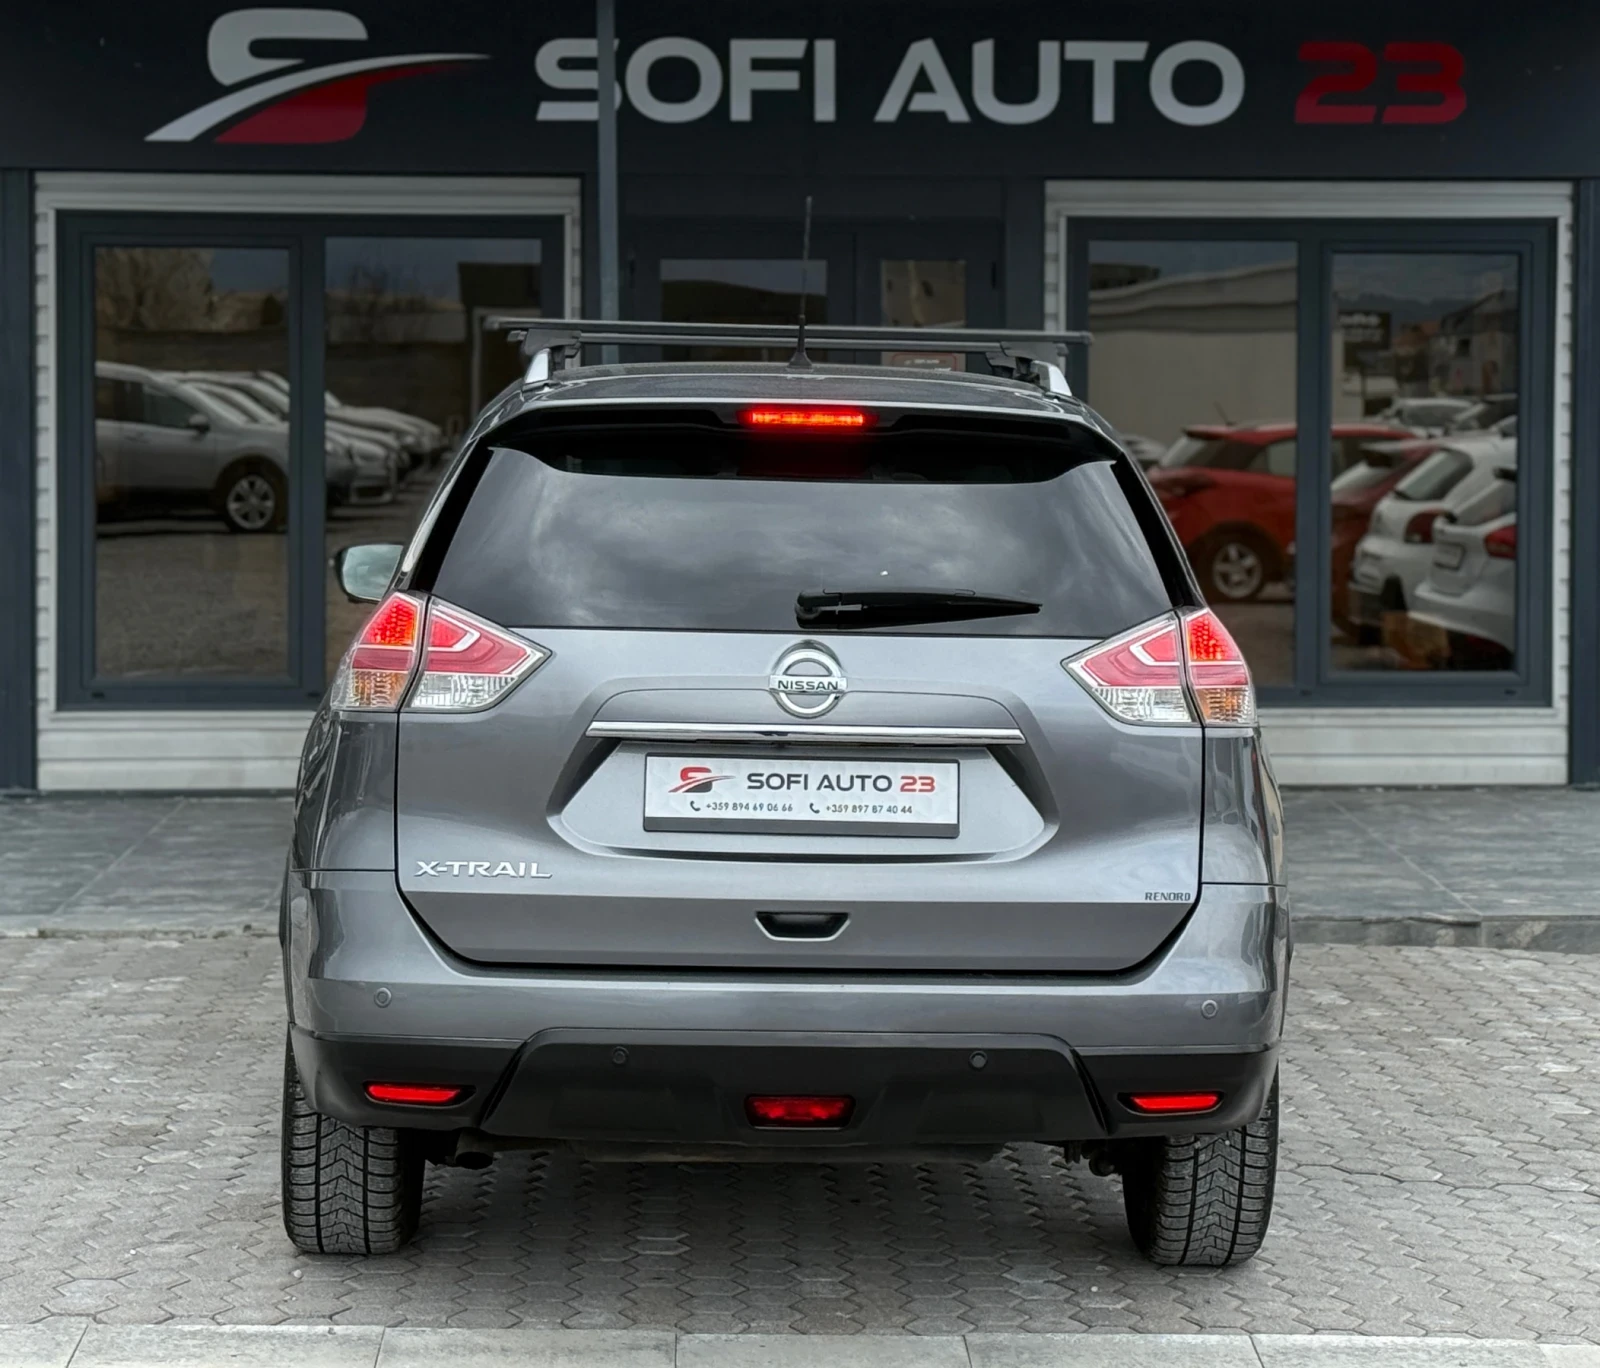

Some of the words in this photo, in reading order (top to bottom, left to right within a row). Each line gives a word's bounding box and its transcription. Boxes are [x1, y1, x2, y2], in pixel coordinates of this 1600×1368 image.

[535, 37, 836, 123] SOFI
[875, 38, 1246, 127] AUTO
[1294, 41, 1467, 125] 23
[778, 680, 838, 690] NISSAN
[747, 772, 809, 791] SOFI
[816, 774, 893, 793] AUTO
[899, 775, 936, 793] 23
[706, 802, 729, 811] +359
[732, 802, 750, 811] 894
[752, 803, 764, 812] 69
[767, 803, 779, 812] 06
[781, 803, 793, 812] 66
[826, 804, 849, 813] +359
[851, 804, 870, 814] 897
[872, 805, 884, 814] 87
[886, 805, 898, 814] 40
[900, 806, 913, 814] 44
[414, 860, 553, 879] X-TRAIL
[1144, 891, 1191, 901] RENORD
